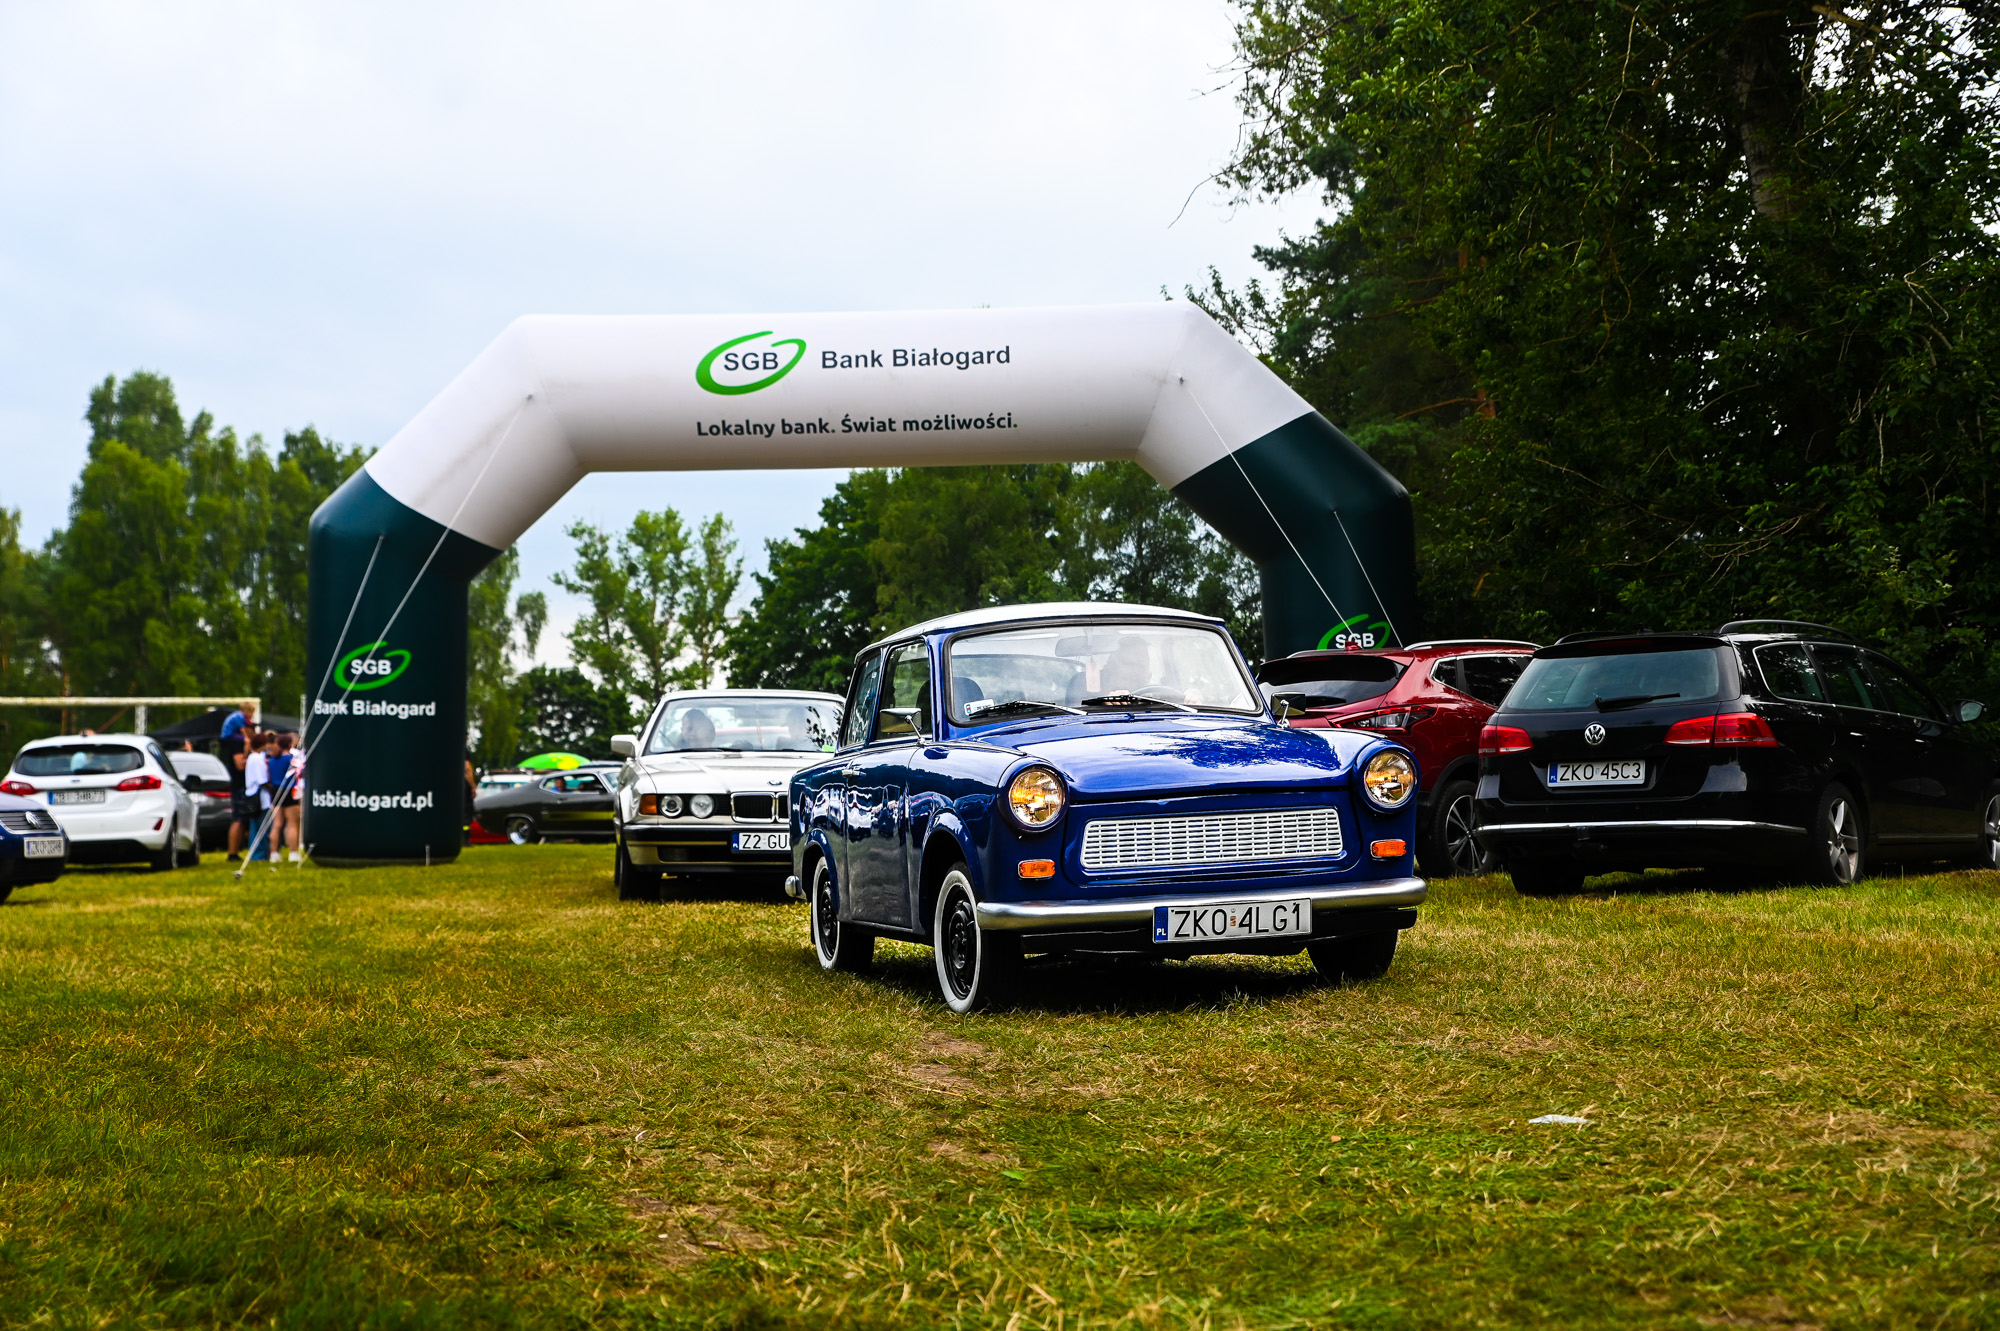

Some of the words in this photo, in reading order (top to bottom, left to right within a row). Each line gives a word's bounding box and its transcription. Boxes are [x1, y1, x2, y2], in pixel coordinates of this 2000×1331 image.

[723, 352, 779, 371] SGB
[821, 349, 884, 369] Bank
[892, 345, 1011, 370] Białogard
[697, 419, 775, 438] Lokalny
[781, 418, 836, 435] bank.
[841, 413, 897, 433] Świat
[902, 412, 1018, 432] możliwości.
[1335, 633, 1375, 649] SGB
[350, 658, 392, 675] SGB
[314, 699, 349, 715] Bank
[1600, 762, 1641, 779] 45C3
[312, 790, 433, 811] bsbialogard.pl
[742, 834, 761, 849] Z2
[767, 834, 790, 849] GU
[1174, 908, 1227, 937] ZKO
[1238, 903, 1300, 934] 4LG1
[1156, 928, 1167, 936] PL
